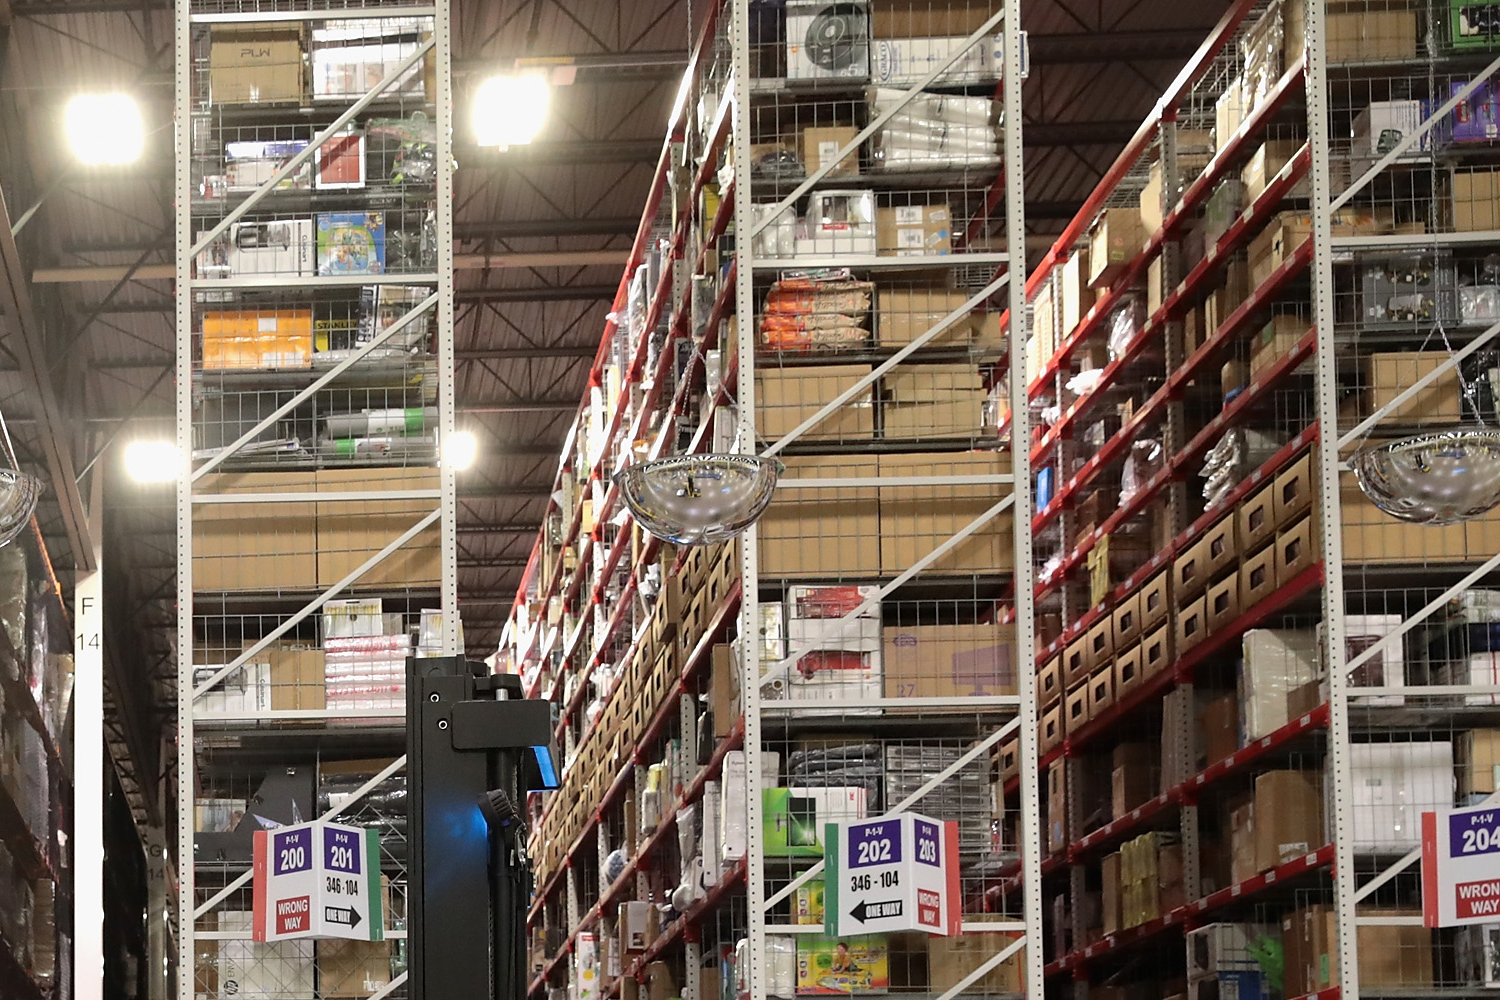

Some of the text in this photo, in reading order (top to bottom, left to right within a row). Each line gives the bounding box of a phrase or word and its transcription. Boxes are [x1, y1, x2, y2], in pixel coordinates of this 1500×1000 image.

[317, 320, 359, 329] STANLEY
[82, 597, 94, 615] F
[76, 633, 100, 650] 14
[1471, 813, 1494, 825] P-1-V
[285, 834, 300, 844] P-1-V
[335, 833, 349, 844] P-1-V
[865, 826, 884, 837] P-1-V
[1462, 826, 1500, 853] 204
[330, 845, 353, 870] 201
[858, 838, 892, 864] 202
[919, 838, 936, 862] 203
[280, 847, 305, 871] 200
[326, 877, 341, 894] 346
[345, 879, 358, 896] 104
[851, 874, 871, 892] 346
[879, 870, 899, 888] 104
[1459, 882, 1500, 899] WRON
[278, 899, 308, 915] WRONG
[865, 902, 901, 918] ONE WAY
[1470, 899, 1500, 914] WAY
[284, 916, 302, 930] WAY
[326, 908, 351, 923] ONE WAY
